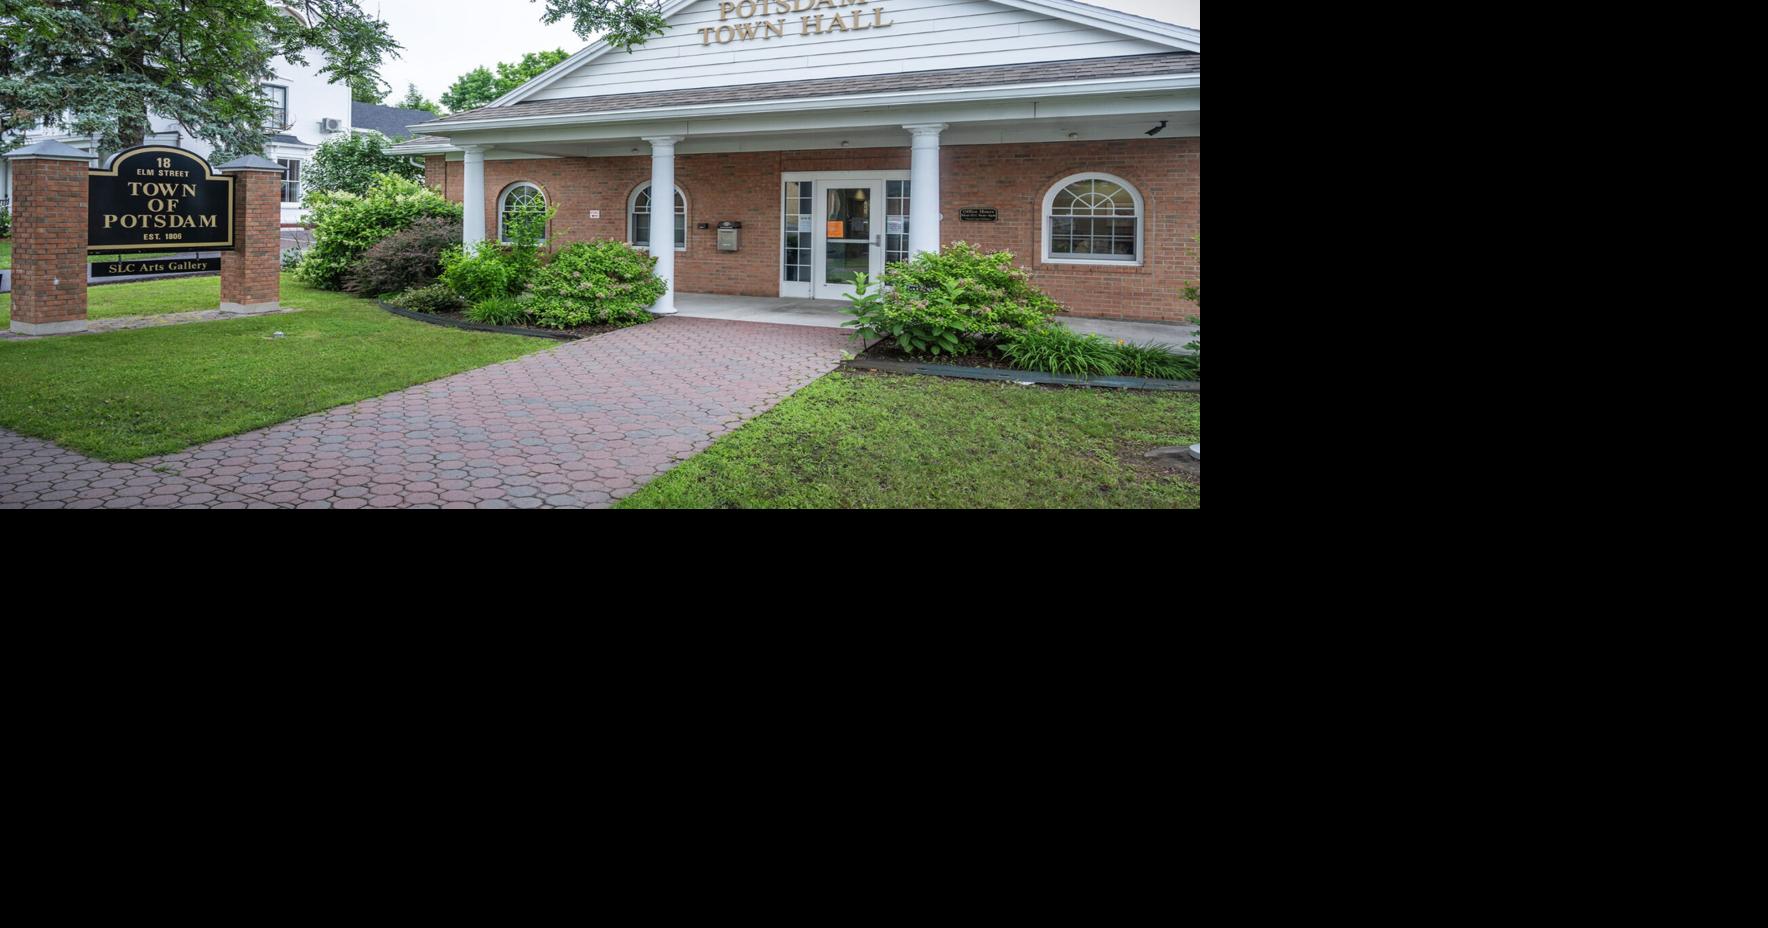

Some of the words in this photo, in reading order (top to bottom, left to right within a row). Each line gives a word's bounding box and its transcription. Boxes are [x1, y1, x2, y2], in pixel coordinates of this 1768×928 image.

[697, 19, 786, 46] TOWN
[800, 7, 894, 36] HALL
[156, 157, 172, 169] 18
[136, 168, 154, 176] ELM
[158, 169, 190, 177] STREET
[127, 182, 198, 197] TOWN
[147, 198, 180, 213] OF
[103, 214, 218, 229] POTSDAM
[108, 263, 135, 273] SLC
[140, 263, 165, 272] Arts
[168, 261, 208, 271] Gallery
